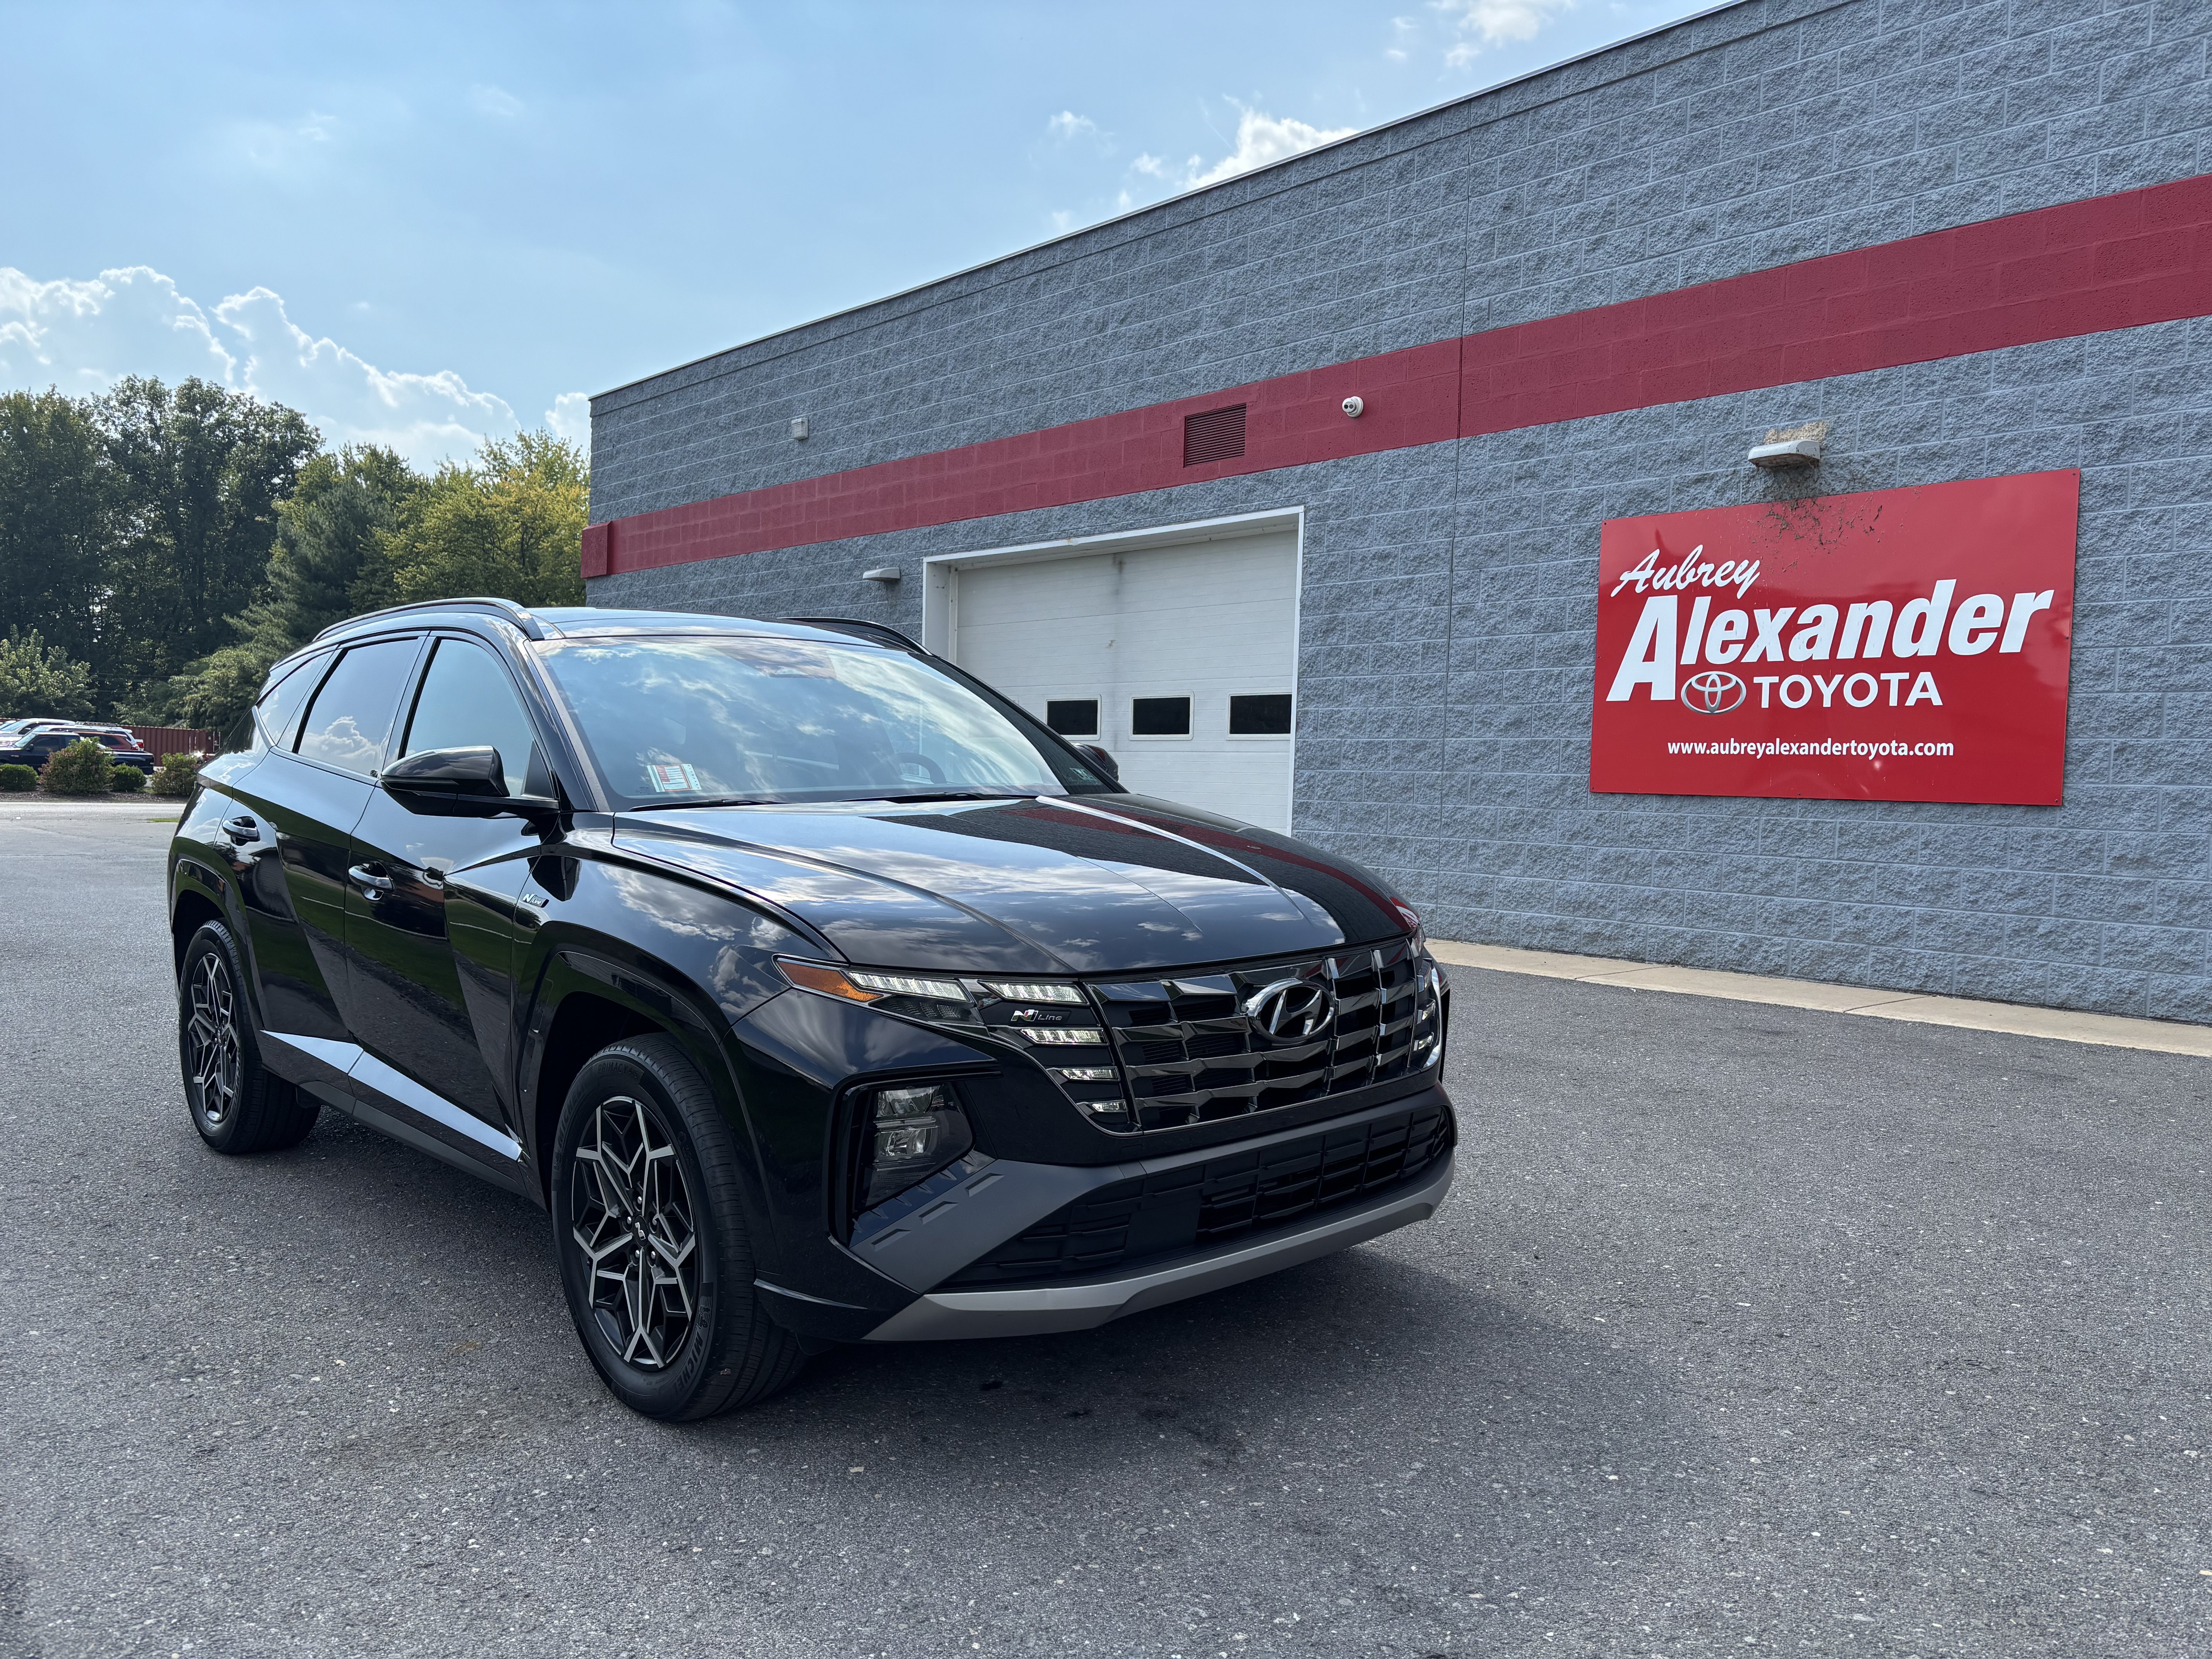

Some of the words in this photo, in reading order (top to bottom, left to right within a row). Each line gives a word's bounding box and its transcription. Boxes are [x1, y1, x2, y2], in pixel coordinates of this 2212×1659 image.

[1611, 544, 1760, 599] Aubrey
[1606, 579, 2054, 701] Alexander
[1753, 672, 1943, 708] TOYOTA
[1668, 738, 1954, 760] www.aubreyalexandertoyota.com
[1011, 1009, 1039, 1022] N
[598, 1062, 629, 1074] PRIMACY
